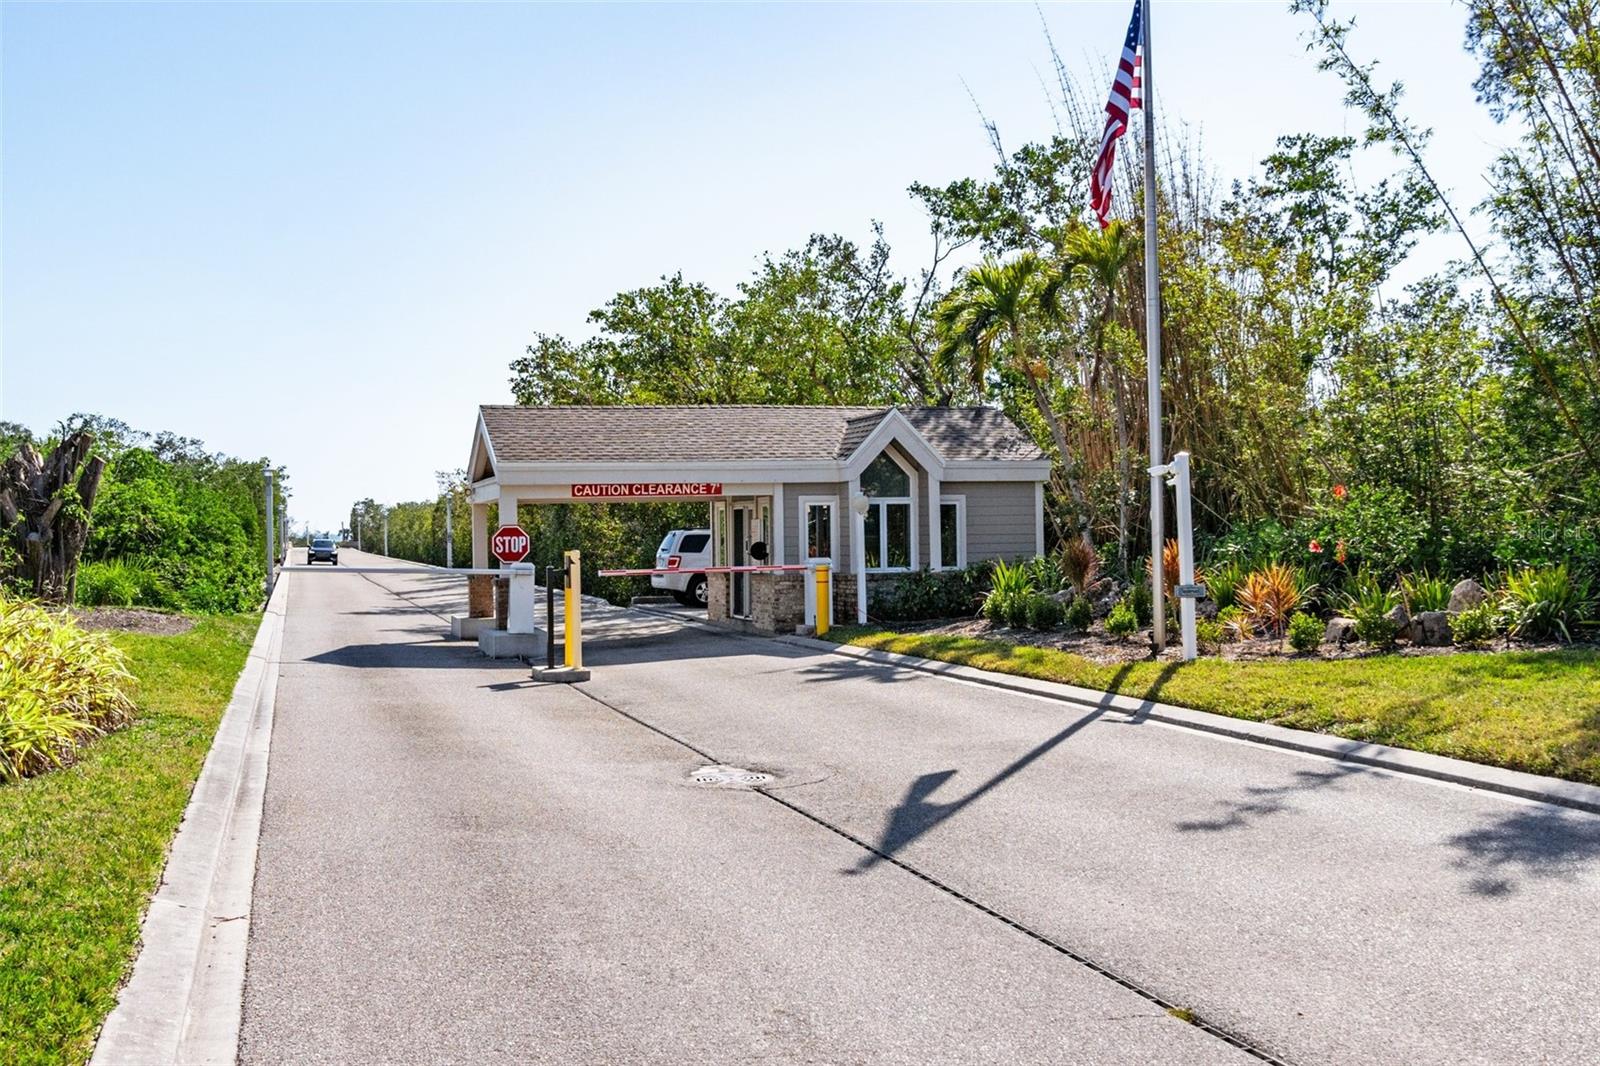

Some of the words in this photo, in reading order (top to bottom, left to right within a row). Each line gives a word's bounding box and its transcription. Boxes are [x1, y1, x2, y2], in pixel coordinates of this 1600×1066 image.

[574, 484, 629, 496] CAUTION
[632, 483, 707, 496] CLEARANCE
[495, 535, 527, 553] STOP
